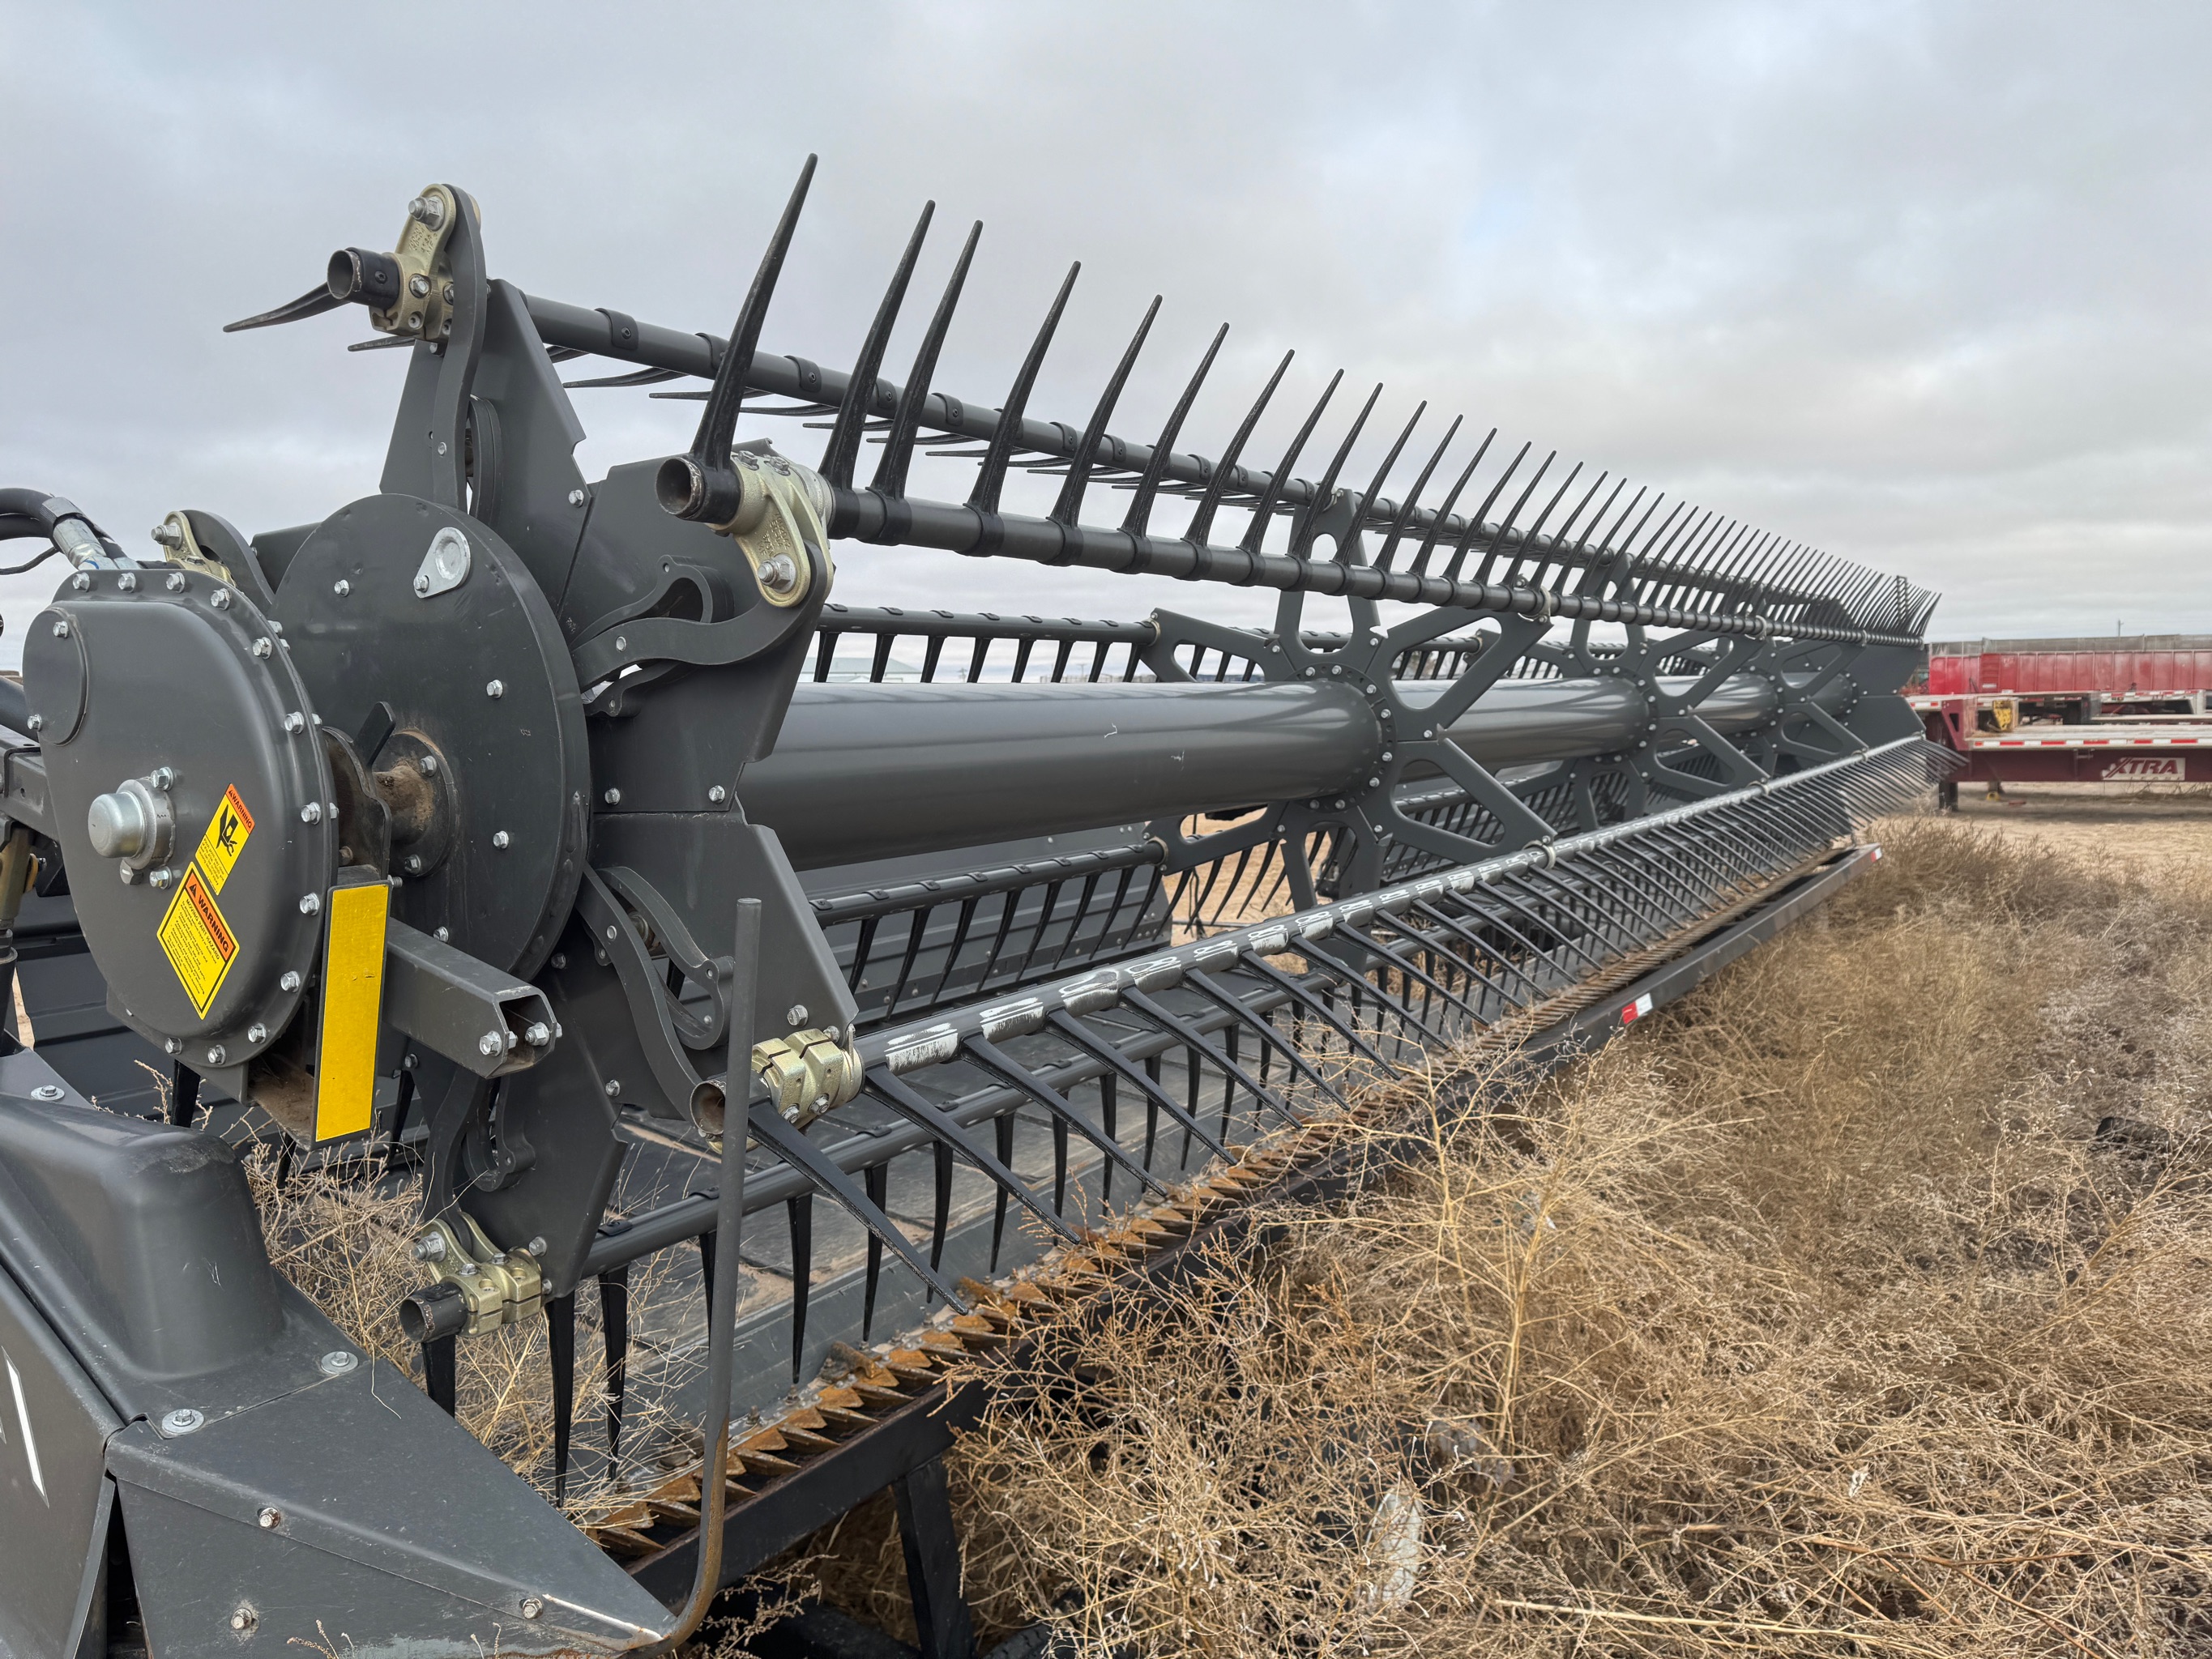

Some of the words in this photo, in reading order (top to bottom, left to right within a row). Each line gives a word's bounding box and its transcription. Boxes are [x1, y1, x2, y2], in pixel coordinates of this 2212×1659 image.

[2104, 757, 2178, 778] XTRA
[232, 793, 252, 829] WARNING
[186, 898, 199, 922] MOVING
[198, 919, 207, 936] PART
[197, 893, 229, 953] WARNING
